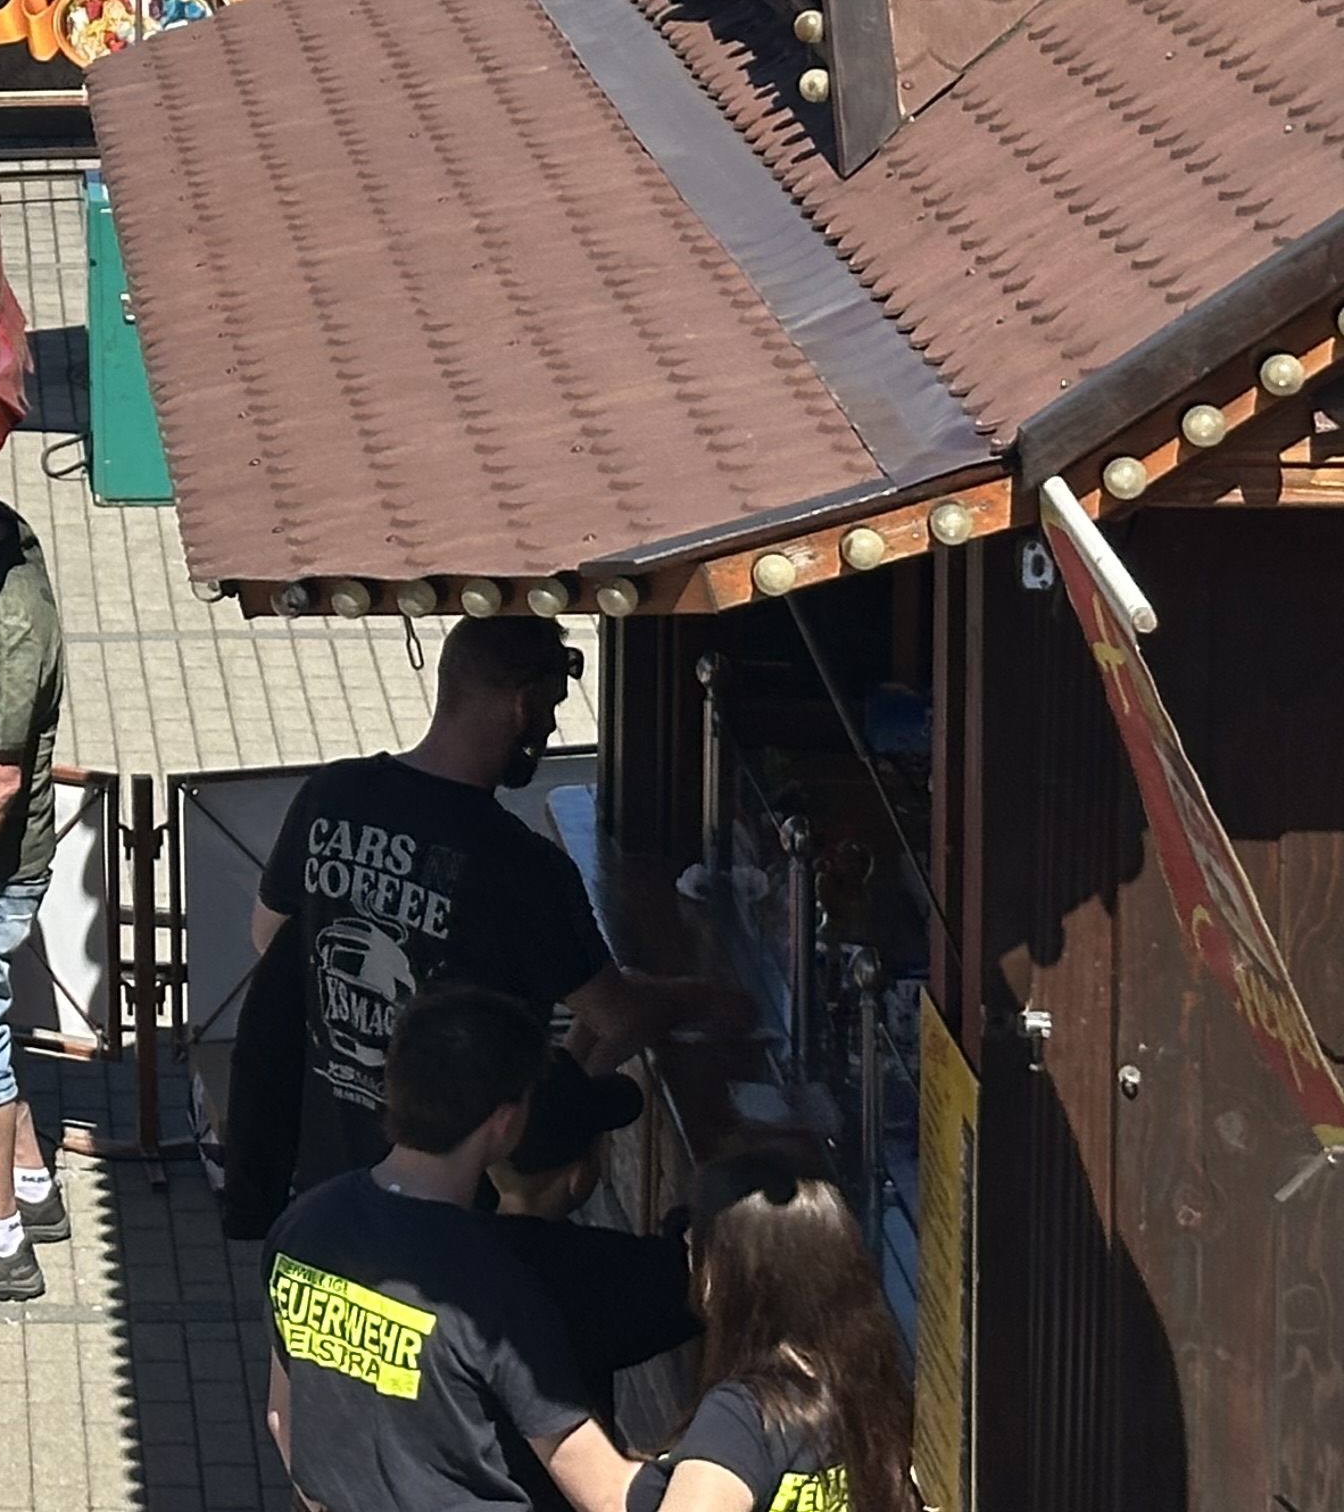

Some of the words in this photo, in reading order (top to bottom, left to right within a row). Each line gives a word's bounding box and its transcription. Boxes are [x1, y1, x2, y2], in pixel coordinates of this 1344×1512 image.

[308, 818, 416, 876] CARS
[304, 857, 451, 939] COFFEE
[272, 1275, 422, 1369] EUERWEHR
[289, 1327, 381, 1381] ELSTRA
